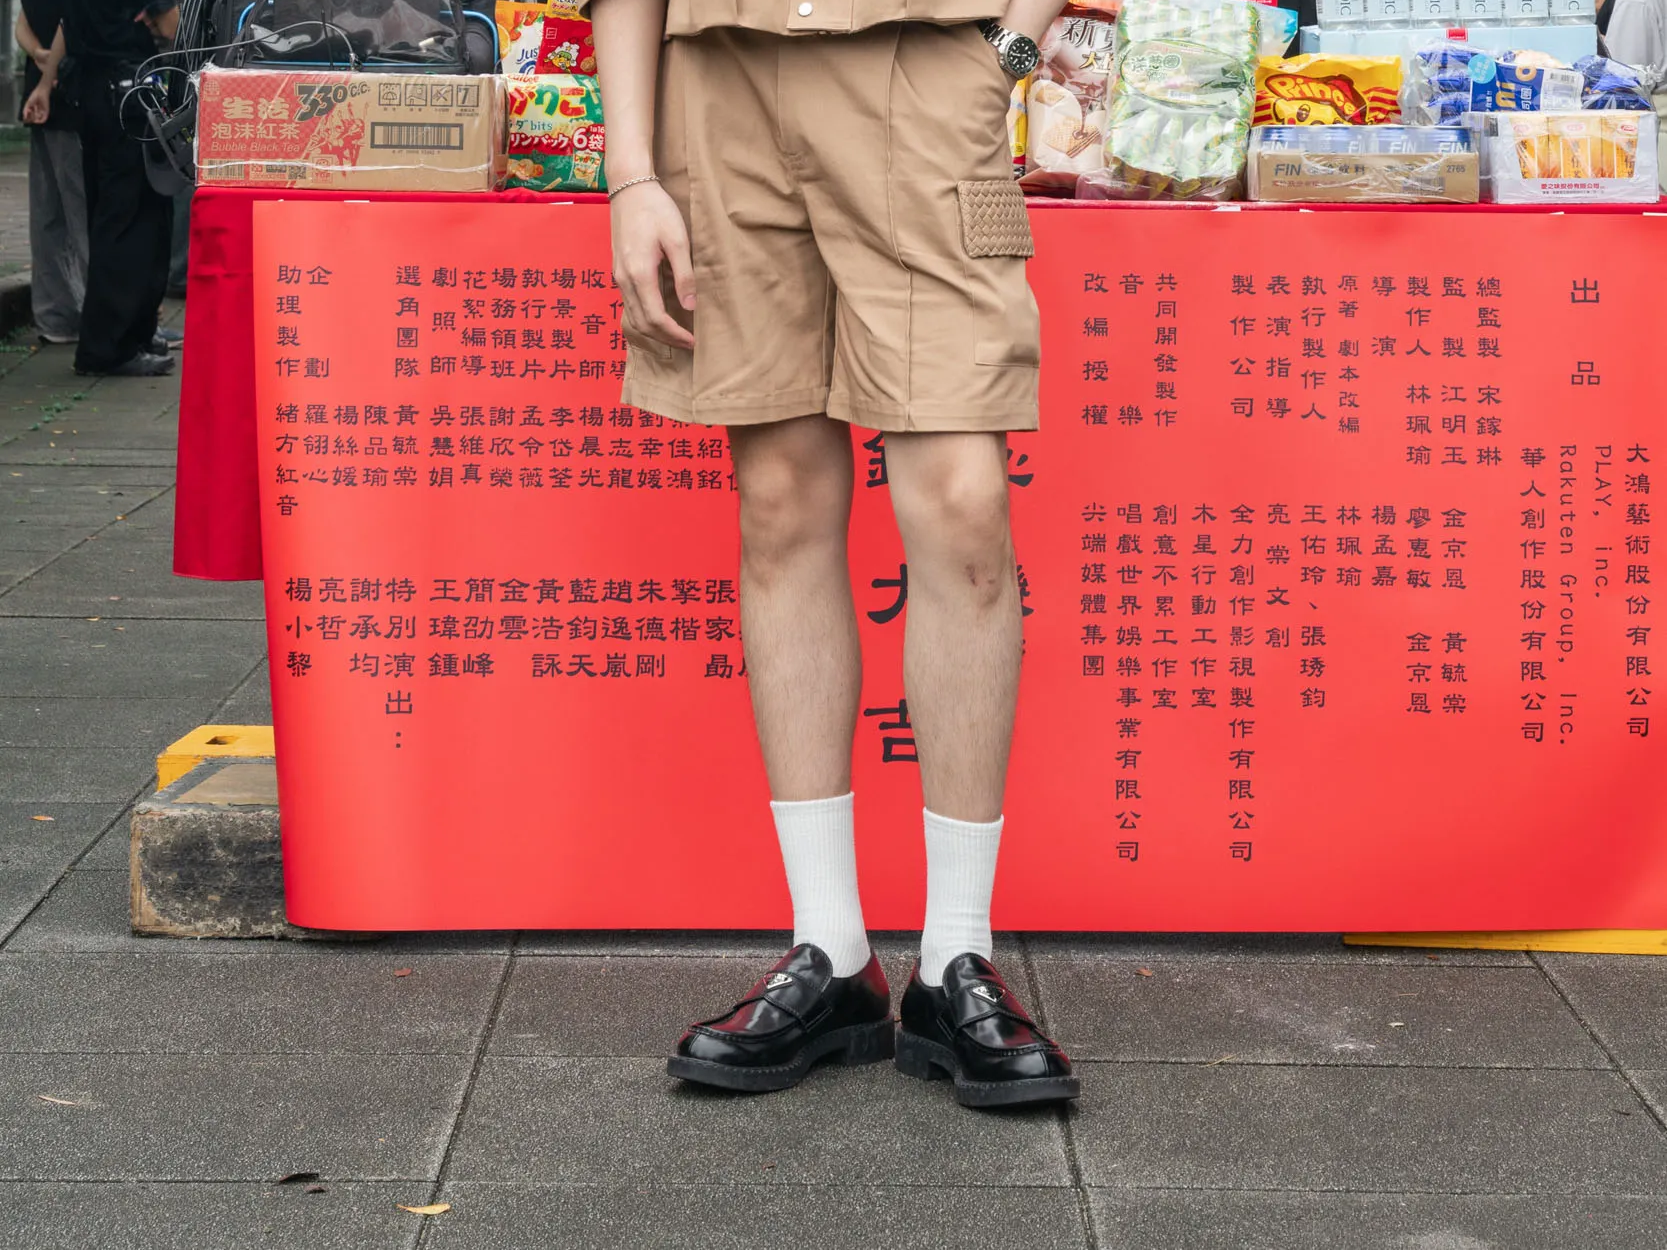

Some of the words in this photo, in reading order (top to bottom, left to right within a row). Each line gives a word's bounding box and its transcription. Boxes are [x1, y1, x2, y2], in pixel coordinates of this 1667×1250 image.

[211, 122, 300, 140] 泡沫紅茶
[222, 96, 290, 120] 生活
[530, 120, 553, 132] bits
[1269, 77, 1356, 116] Prince
[210, 141, 248, 152] Bubble
[250, 141, 279, 152] Black
[282, 142, 301, 152] Tea
[1274, 163, 1302, 176] FIN
[275, 265, 301, 376] 助理製作
[304, 265, 332, 378] 企劃
[395, 265, 422, 378] 選角團隊
[430, 267, 457, 375] 劇照師
[460, 270, 487, 376] 花絮編導
[490, 267, 518, 379] 場務領班
[519, 268, 548, 380] 執行製片
[549, 268, 577, 381] 場景製片
[579, 269, 607, 380] 收音師
[1081, 273, 1109, 426] 改編授權
[1117, 273, 1145, 426] 音樂
[1153, 273, 1178, 427] 共同開發製作
[1230, 274, 1257, 418] 製作公司
[1266, 275, 1292, 419] 表演指導
[1300, 275, 1327, 420] 執行製作人
[1371, 276, 1397, 357] 導演
[1405, 276, 1432, 356] 製作人
[1441, 276, 1467, 358] 監製
[1476, 277, 1502, 358] 總監製
[1570, 277, 1601, 386] 出品
[275, 404, 299, 516] 緒方紅音
[332, 405, 359, 487] 楊絲媛
[362, 405, 389, 487] 陳品瑜
[392, 404, 420, 486] 黃毓棠
[428, 405, 456, 488] 吳慧娟
[459, 406, 486, 485] 張維真
[488, 406, 515, 488] 謝欣榮
[518, 405, 545, 488] 孟令薇
[578, 406, 605, 488] 楊晨光
[607, 407, 634, 489] 楊志龍
[666, 420, 694, 491] 佳鴻
[696, 424, 723, 490] 紹銘
[1406, 384, 1432, 465] 林珮瑜
[1441, 385, 1467, 465] 江明玉
[1336, 505, 1363, 587] 林珮瑜
[1371, 505, 1398, 587] 楊孟嘉
[1559, 444, 1577, 554] Rakuten
[1080, 502, 1108, 677] 尖端媒體集團
[1265, 503, 1291, 648] 亮棠文創
[1405, 507, 1432, 589] 廖惠敏
[1441, 508, 1467, 590] 金京恩
[1520, 447, 1547, 743] 華人創作股份有限公司
[1624, 443, 1652, 738] 大鴻藝術股份有限公司
[285, 577, 313, 677] 楊小黎
[316, 577, 347, 640] 亮哲
[349, 577, 383, 678] 謝承均
[462, 577, 495, 678] 簡劭峰
[497, 578, 530, 640] 金雲
[531, 578, 565, 678] 黃浩詠
[565, 577, 599, 678] 藍鈞天
[599, 578, 633, 678] 趙逸嵐
[634, 578, 668, 678] 朱德剛
[1151, 504, 1178, 710] 創意不累工作室
[1190, 503, 1217, 709] 木星行動工作室
[1555, 574, 1578, 663] Group,
[1115, 503, 1143, 863] 唱戲世界娛樂事業有限公司
[1228, 503, 1256, 862] 全力創作影視製作有限公司
[1406, 632, 1432, 714] 金京恩
[1441, 631, 1468, 714] 黃毓棠
[1559, 693, 1577, 745] Inc.
